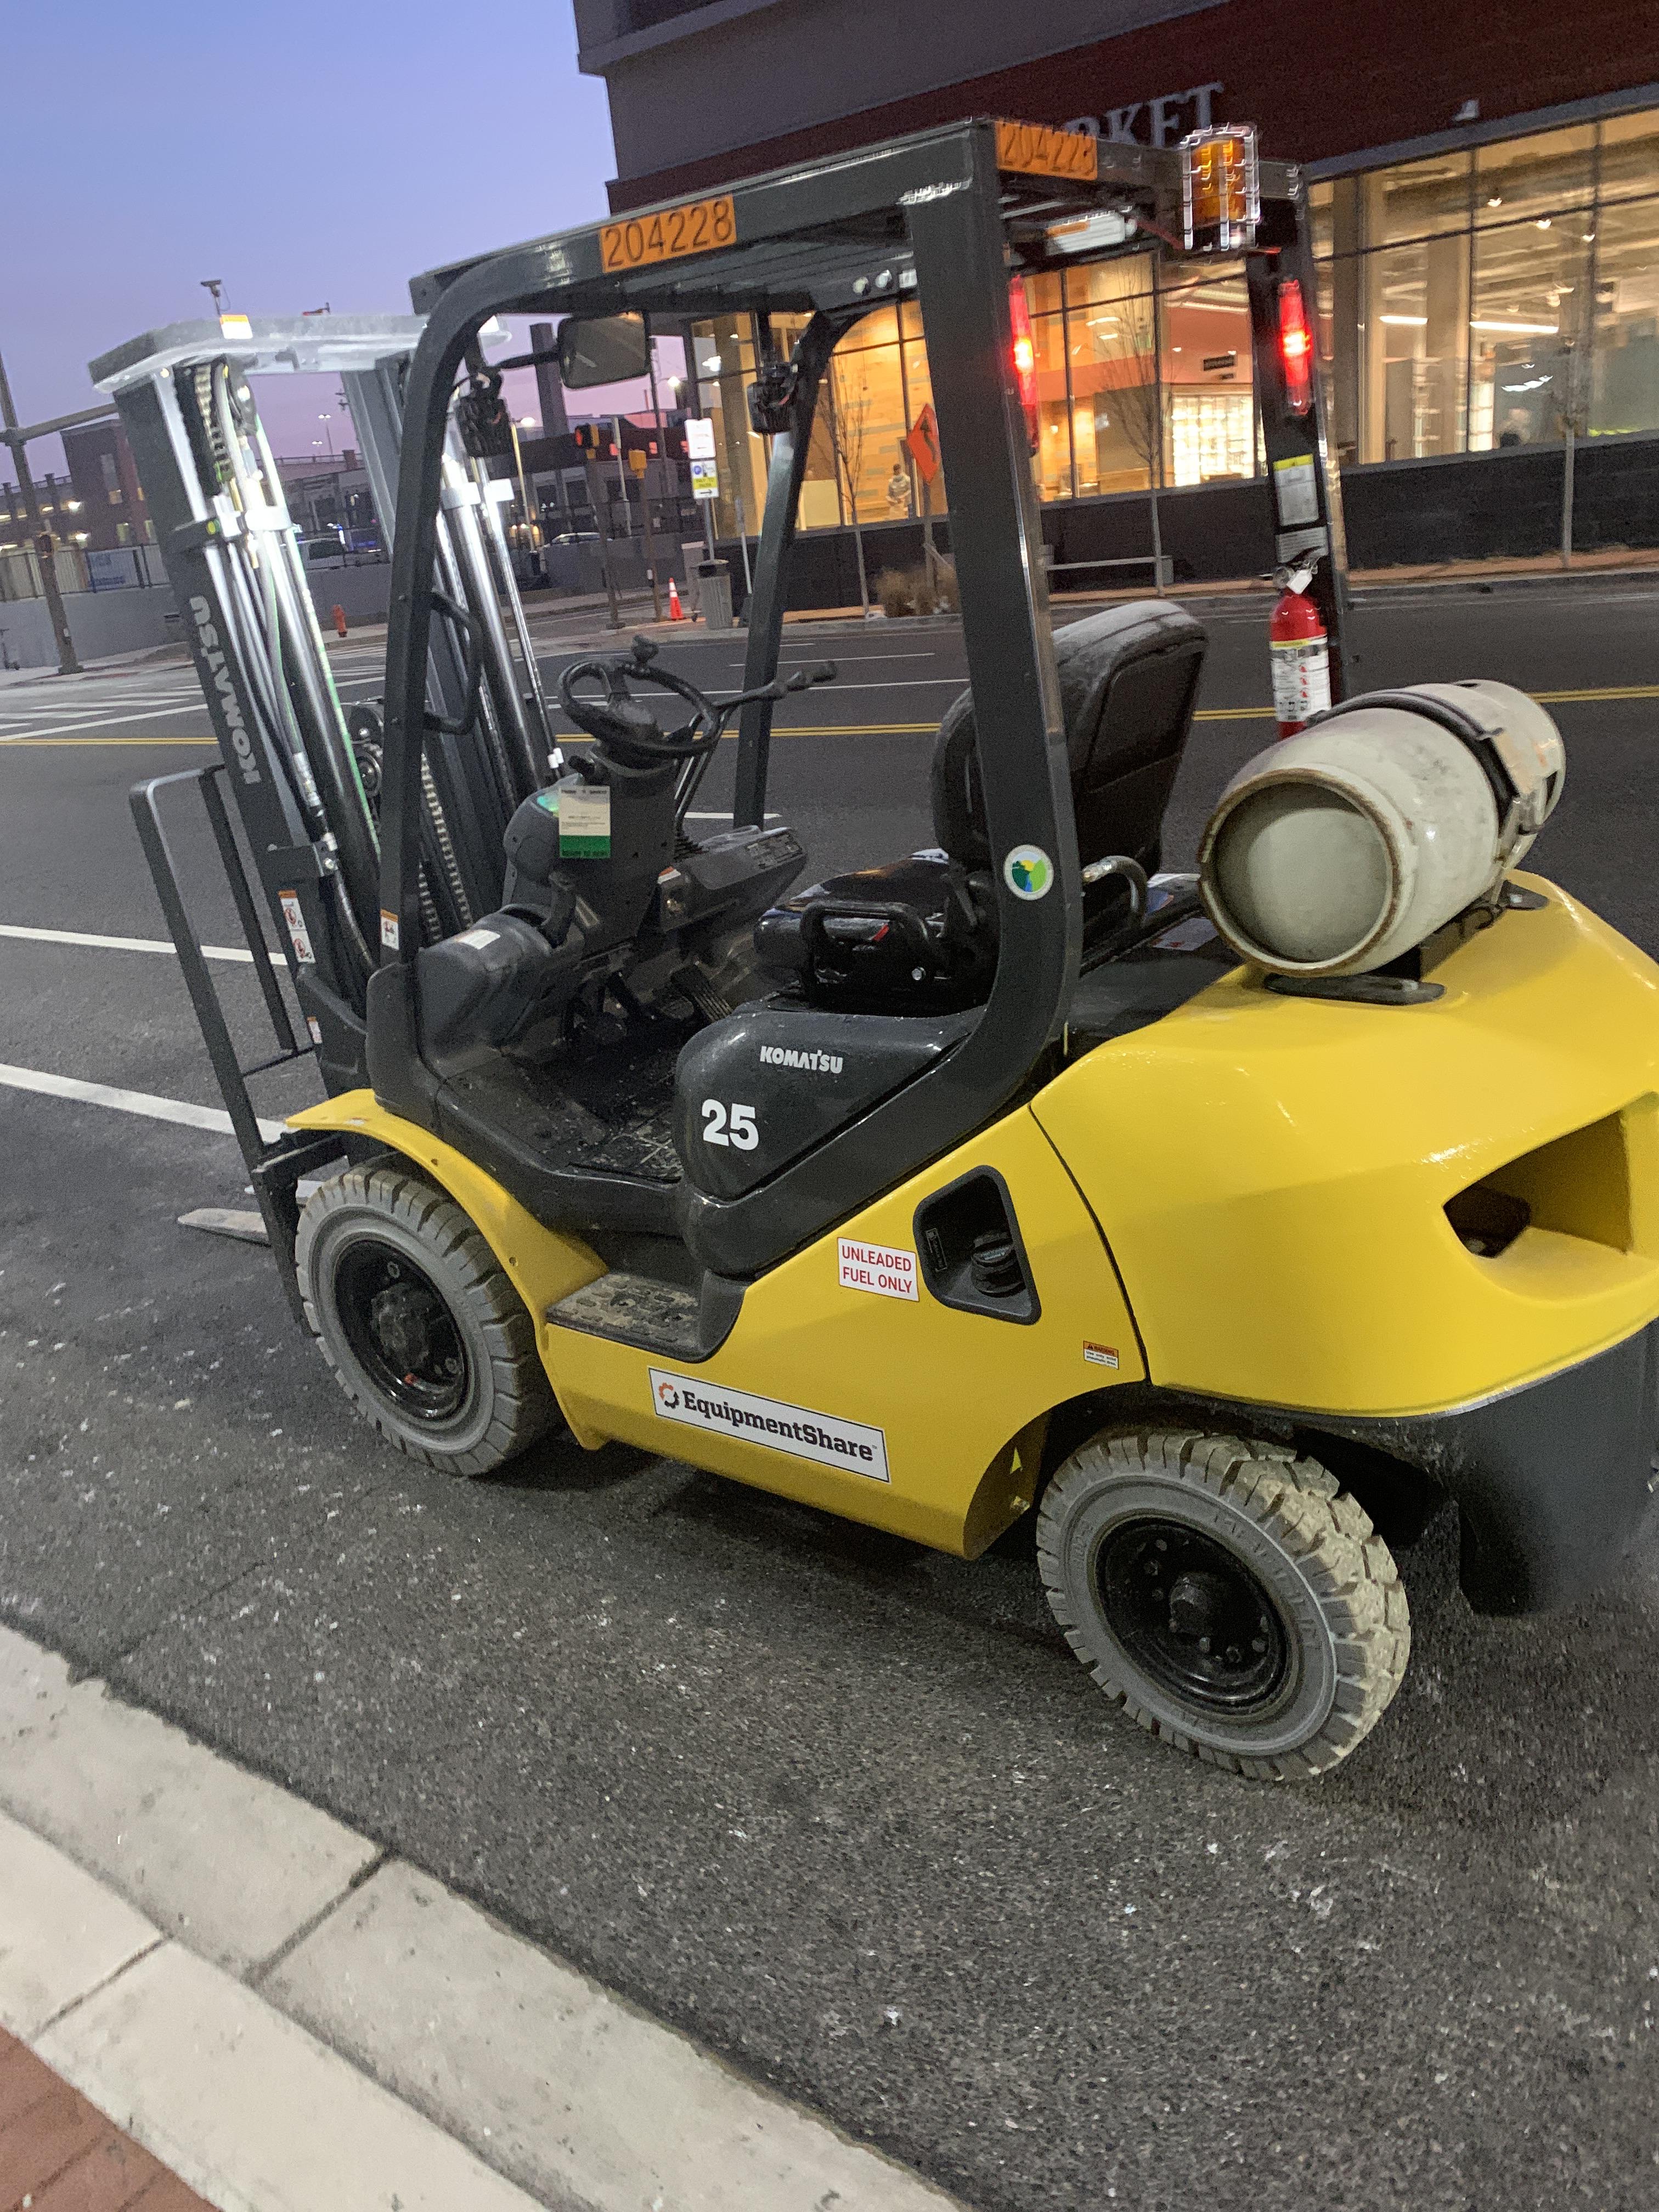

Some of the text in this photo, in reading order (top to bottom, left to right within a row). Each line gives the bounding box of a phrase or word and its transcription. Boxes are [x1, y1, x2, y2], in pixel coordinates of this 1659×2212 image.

[605, 200, 732, 267] 204228
[190, 595, 261, 785] KOMATSU
[760, 1045, 844, 1074] KOMATSU
[702, 1098, 759, 1151] 25
[842, 1245, 912, 1272] UNLEADED
[843, 1266, 912, 1293] FUEL ONLY
[682, 1390, 874, 1462] EquipmentShare
